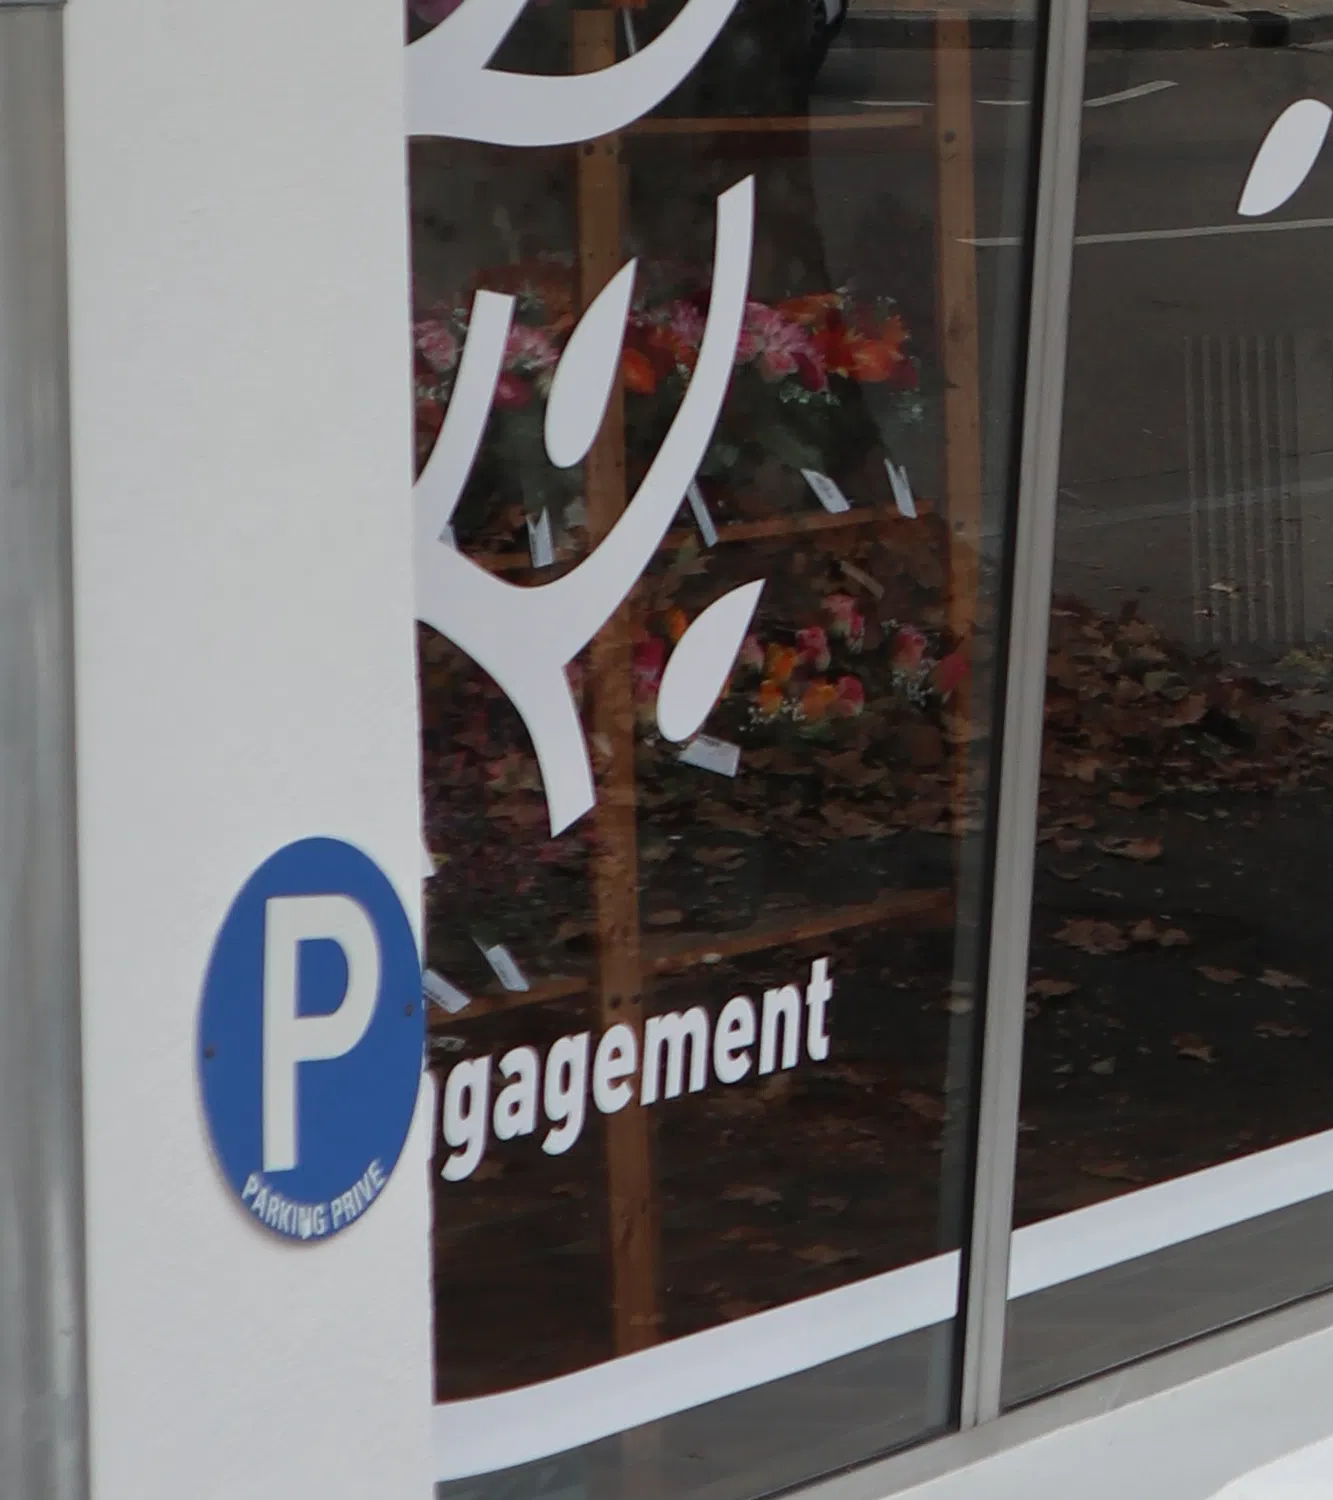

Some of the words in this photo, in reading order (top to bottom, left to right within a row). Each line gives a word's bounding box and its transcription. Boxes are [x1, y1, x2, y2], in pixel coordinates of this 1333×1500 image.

[262, 892, 382, 1173] P
[241, 1171, 326, 1240] PARKING
[330, 1157, 387, 1230] PRIVE
